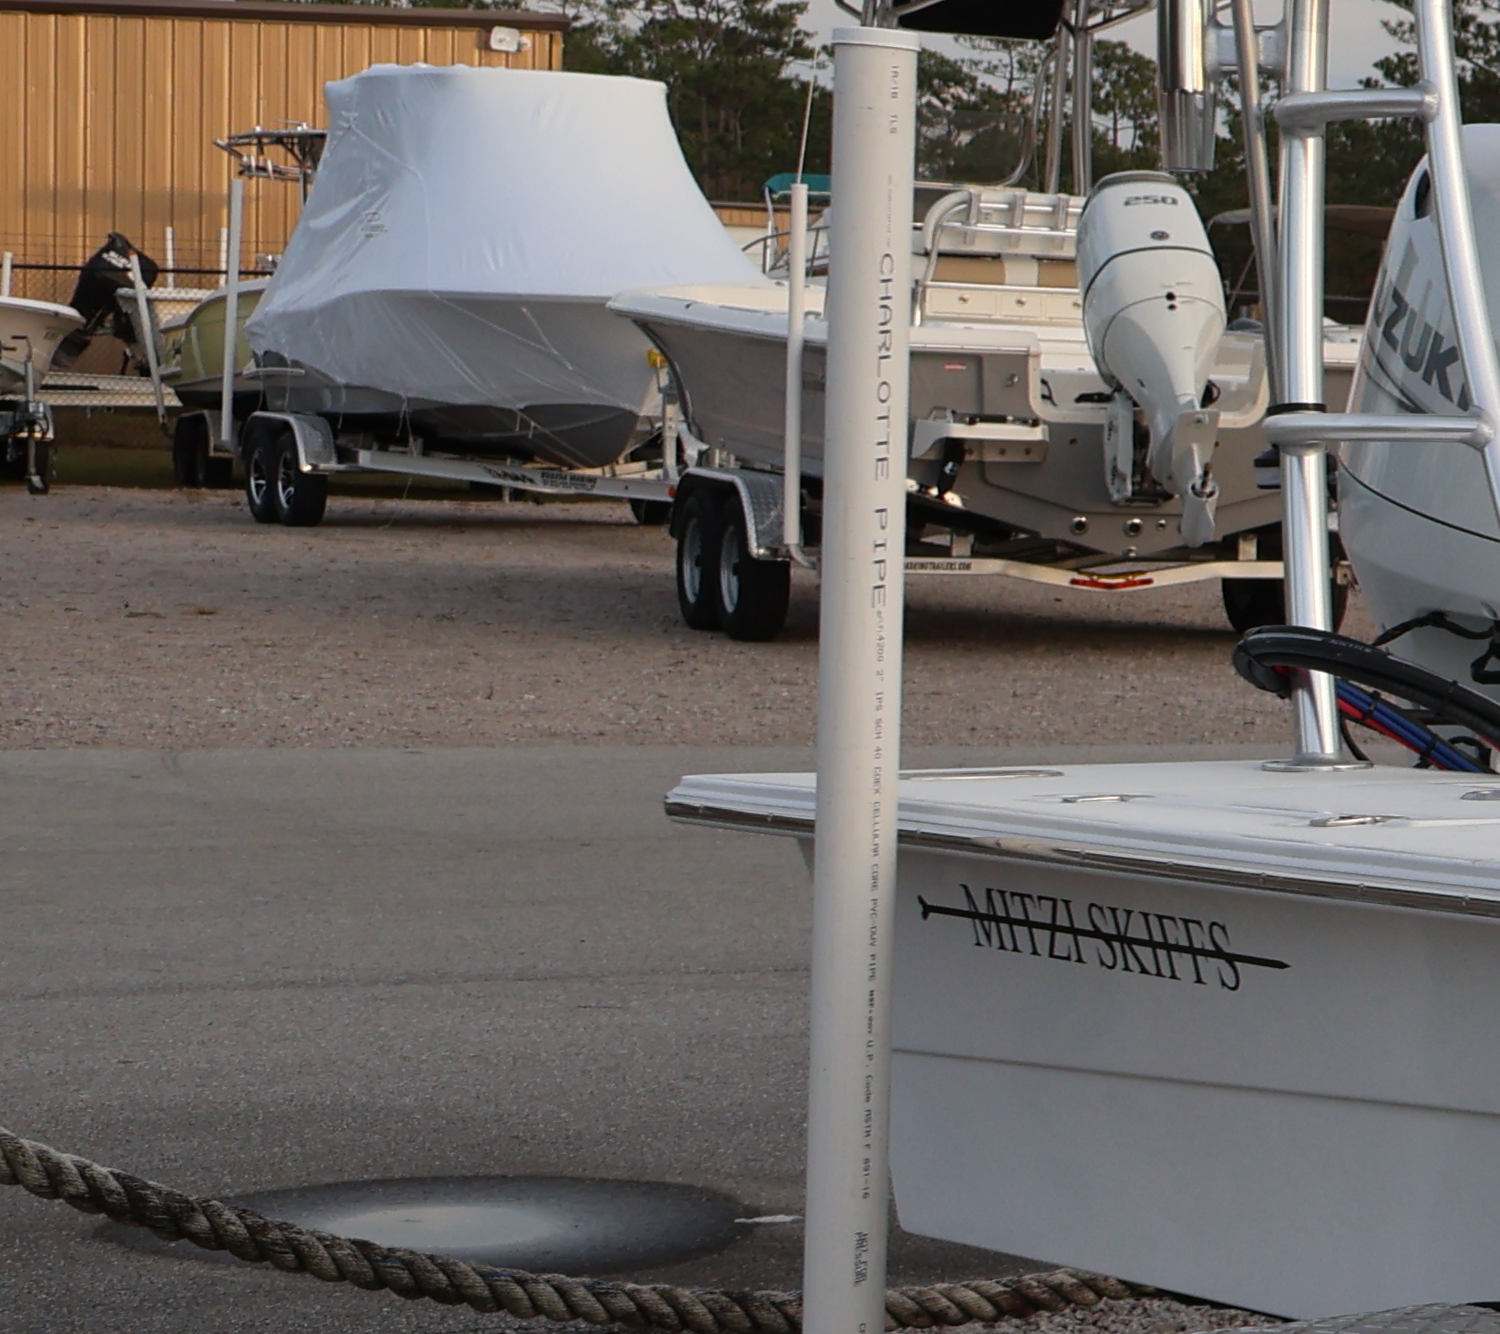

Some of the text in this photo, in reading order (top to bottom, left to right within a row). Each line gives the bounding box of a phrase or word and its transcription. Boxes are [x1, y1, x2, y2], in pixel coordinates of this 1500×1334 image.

[1123, 194, 1179, 207] 250
[874, 252, 894, 482] CHARLOTTE
[873, 507, 888, 609] PIPE
[959, 883, 1241, 992] MITZI SKIFFS
